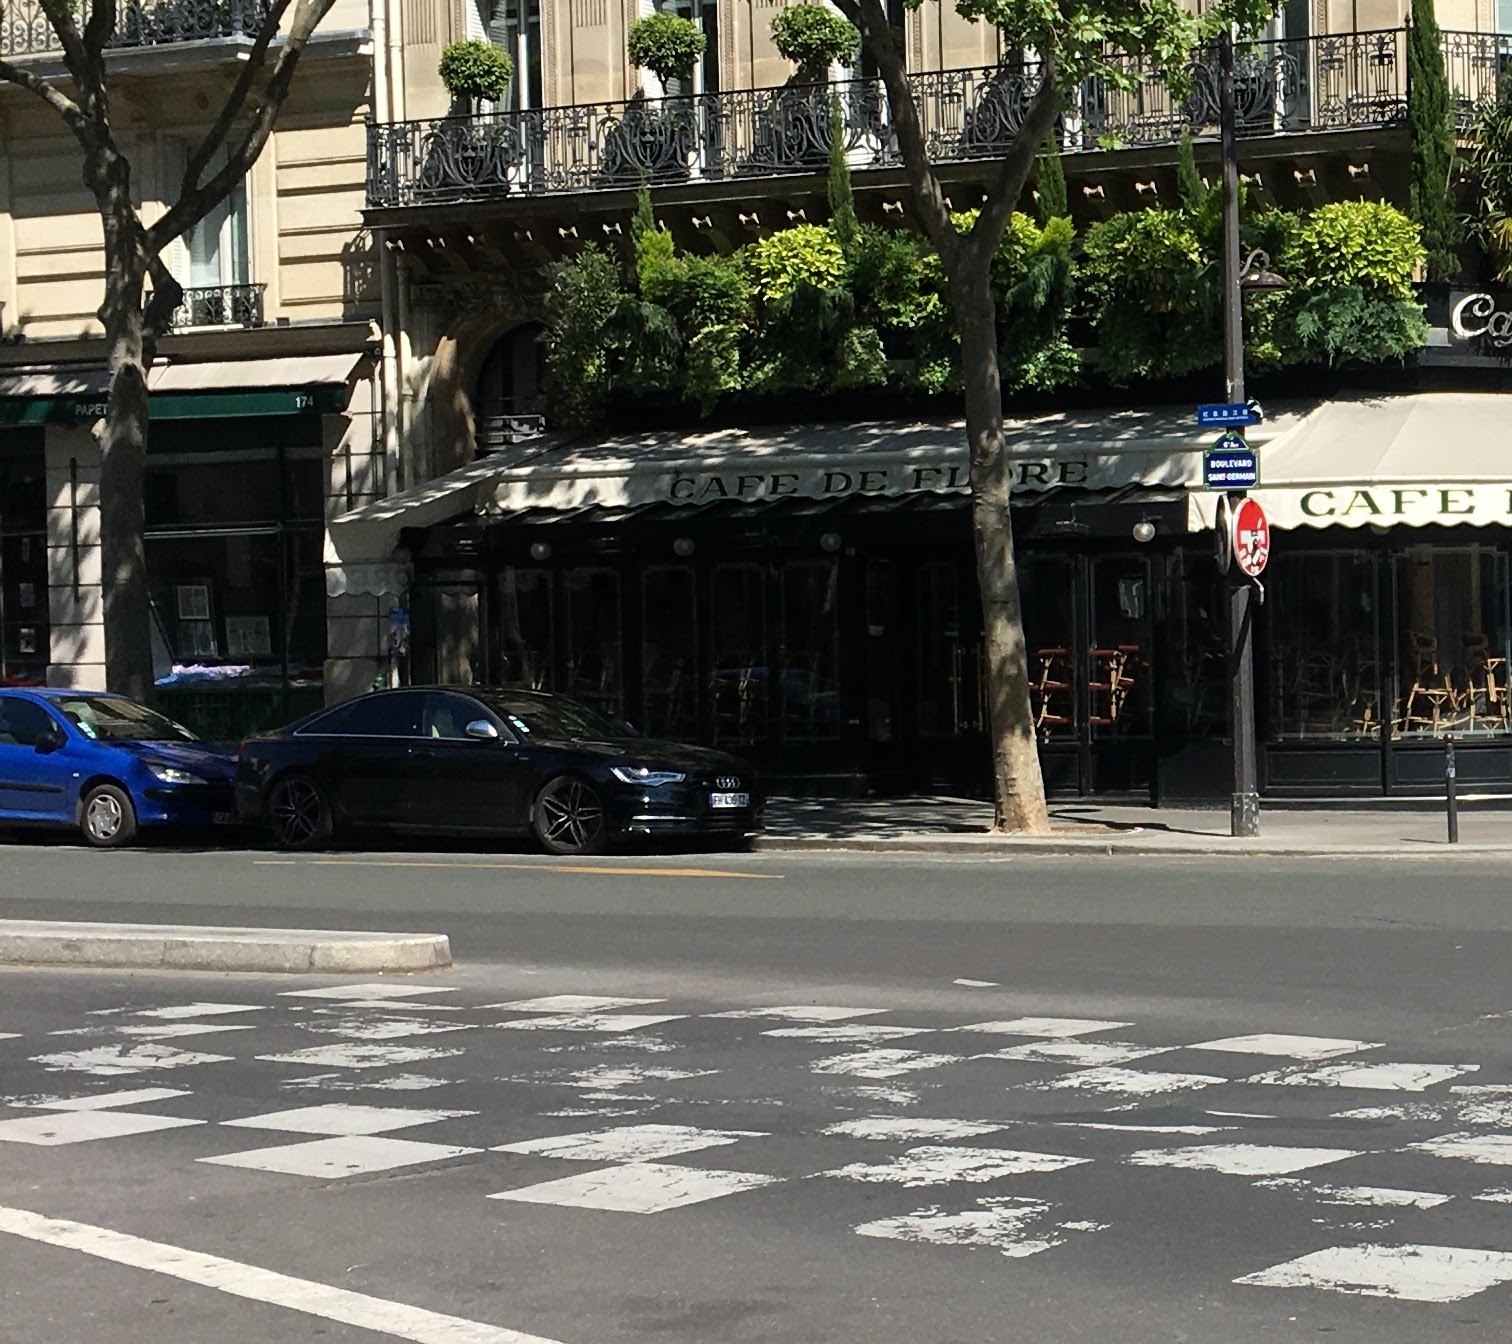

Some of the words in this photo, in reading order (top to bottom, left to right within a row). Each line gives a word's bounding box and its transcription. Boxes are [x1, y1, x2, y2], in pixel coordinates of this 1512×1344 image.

[295, 395, 314, 408] 174
[1210, 459, 1253, 469] BOULEVARD
[670, 472, 799, 499] CAFE
[823, 469, 889, 494] DE
[912, 460, 1089, 490] FLRE
[1207, 472, 1256, 482] SAINT-GERMAIN
[1300, 488, 1476, 517] CAFE
